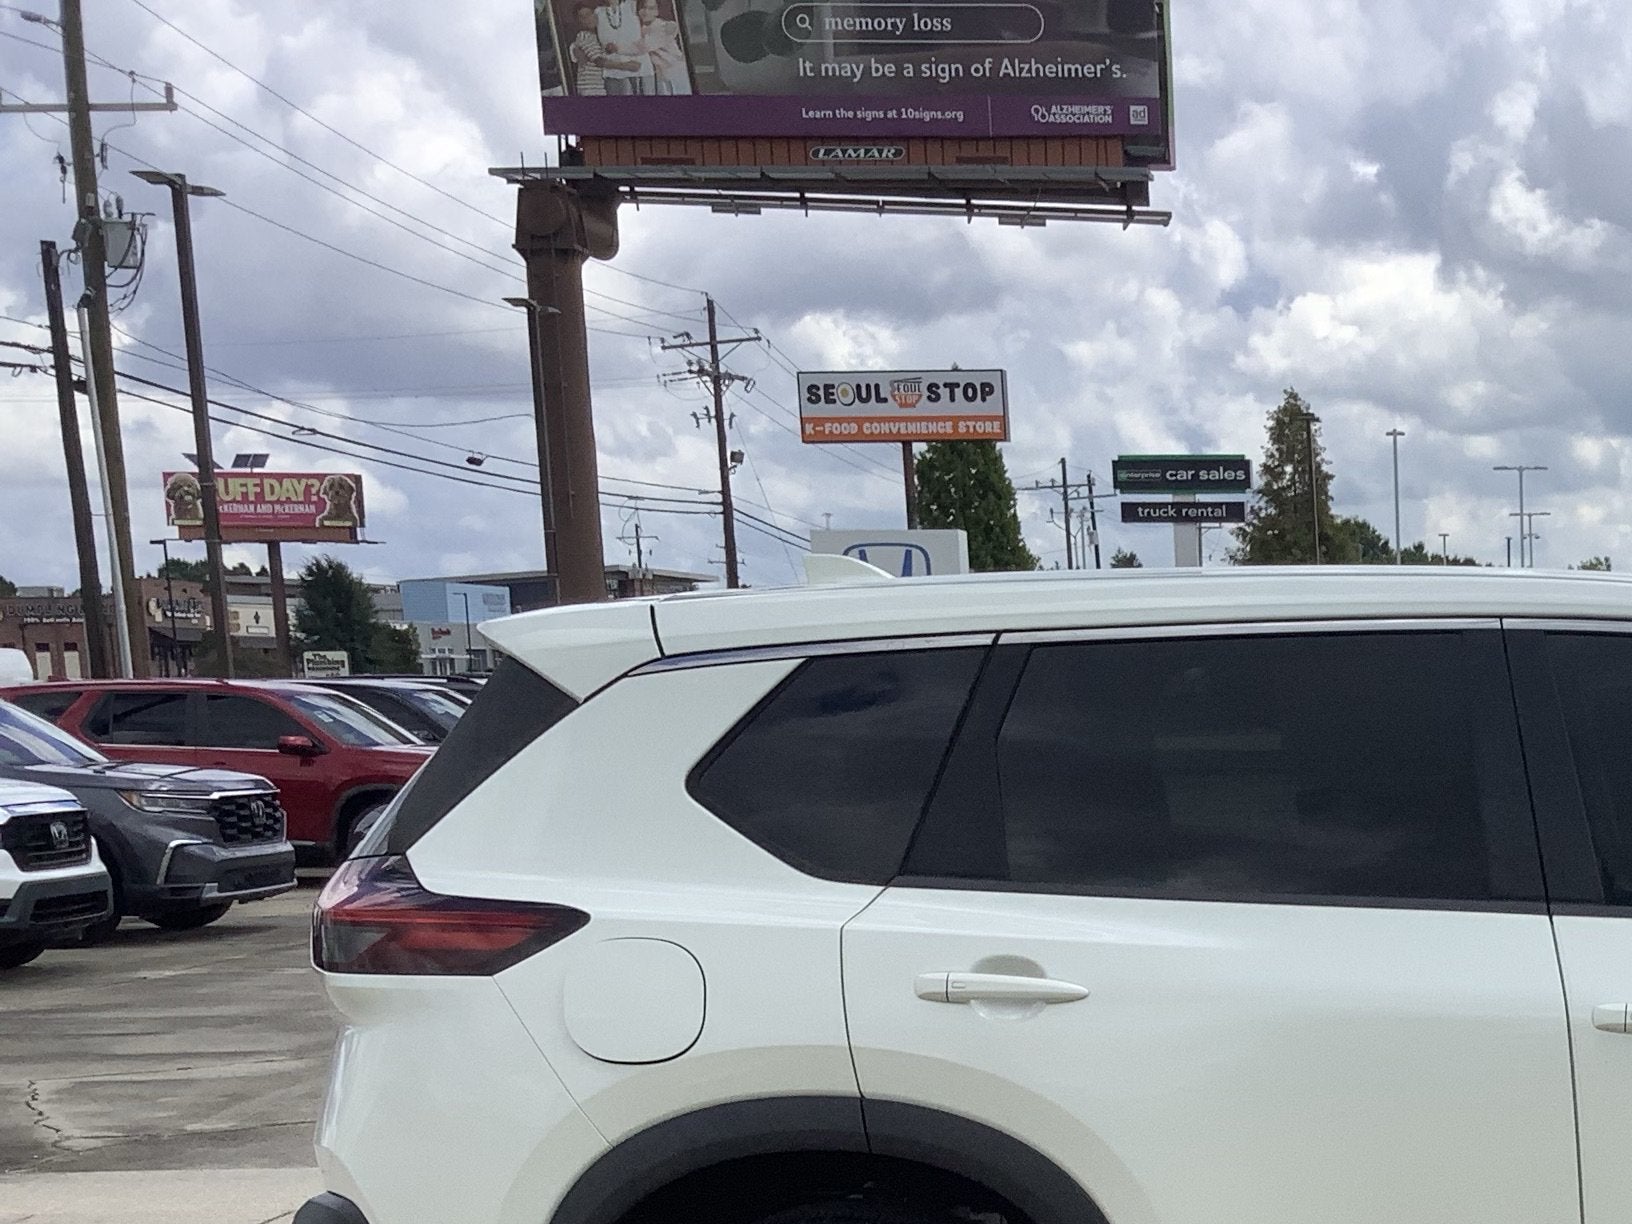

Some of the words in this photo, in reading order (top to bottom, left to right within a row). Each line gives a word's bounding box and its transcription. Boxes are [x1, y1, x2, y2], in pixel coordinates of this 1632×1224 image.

[824, 16, 906, 35] memory
[913, 13, 952, 31] loss
[800, 58, 815, 77] It
[821, 62, 864, 82] may
[871, 58, 896, 77] be
[903, 63, 914, 77] a
[921, 57, 963, 83] sign
[970, 58, 993, 77] of
[1000, 57, 1127, 78] Alzheimer's.
[802, 107, 833, 119] Learn
[836, 107, 854, 119] the
[856, 107, 884, 121] signs
[887, 108, 898, 118] at
[901, 107, 964, 122] 10signs.org
[1048, 114, 1113, 123] ASSOCIATION
[817, 148, 896, 159] LAMAR
[807, 382, 888, 406] SEOUL
[927, 382, 994, 403] STOP
[805, 422, 858, 435] K-FOOD
[863, 421, 954, 434] CONVENIENCE
[958, 421, 1001, 434] STORE
[1165, 469, 1195, 480] car
[1199, 466, 1246, 480] sales
[217, 477, 261, 501] UFF
[264, 477, 320, 502] DAY?
[1137, 505, 1177, 517] truck
[1182, 504, 1226, 517] rental
